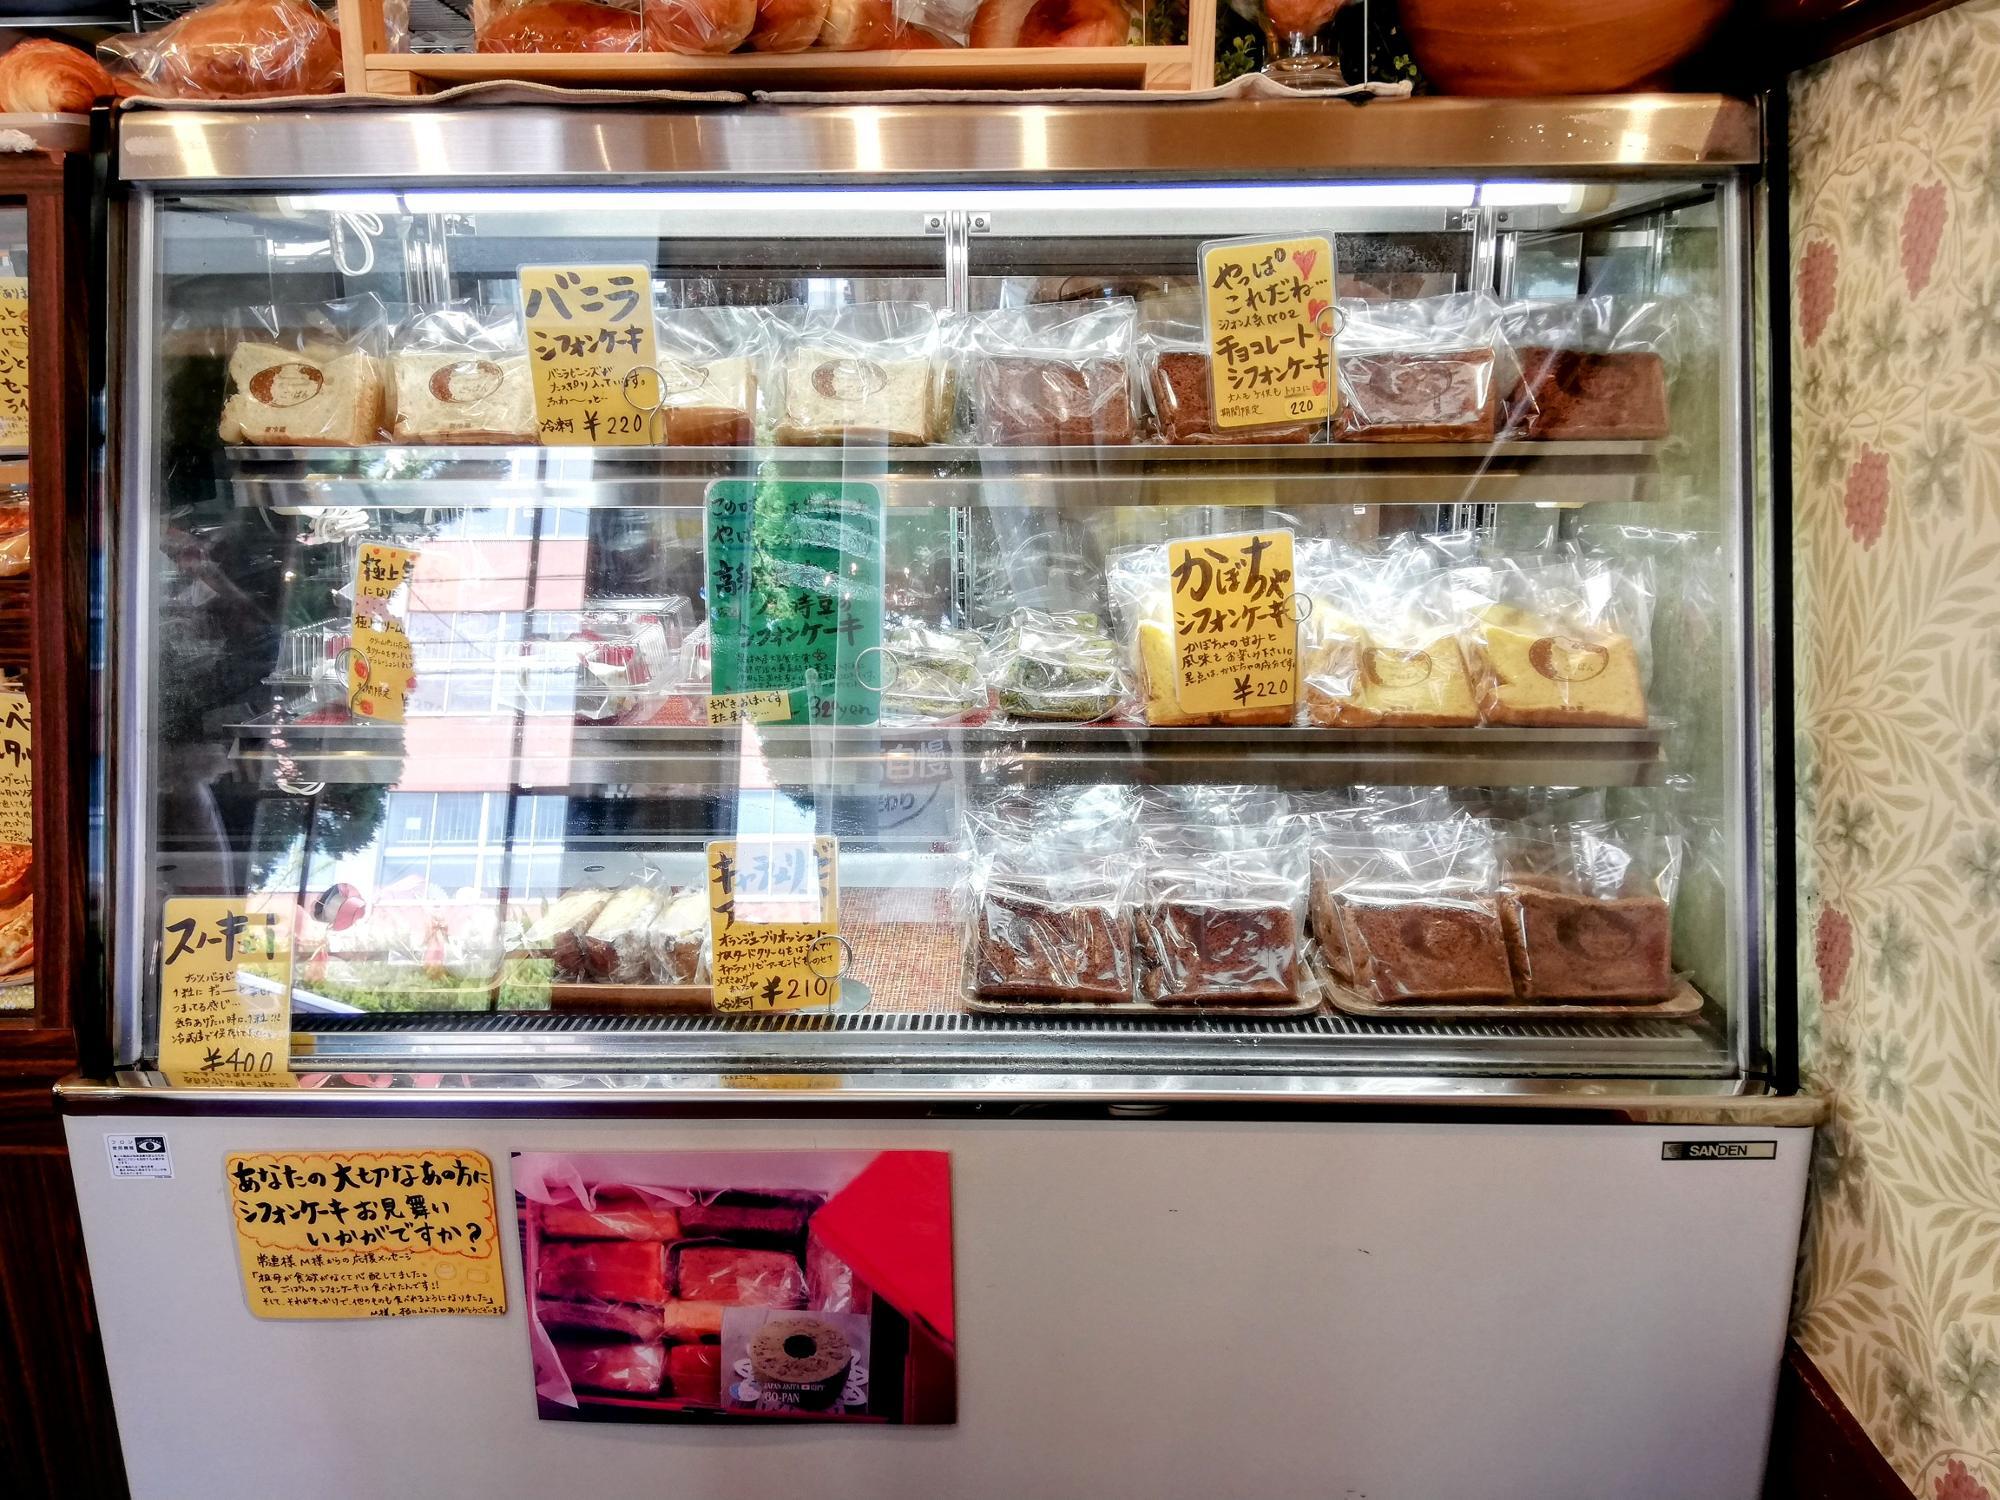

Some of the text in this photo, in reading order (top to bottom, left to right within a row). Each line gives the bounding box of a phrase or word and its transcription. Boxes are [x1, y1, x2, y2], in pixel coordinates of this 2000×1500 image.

[1212, 248, 1286, 290] やっぱ
[526, 272, 640, 321] バニラ
[1215, 323, 1314, 366] チョコレート
[1290, 399, 1314, 415] 220
[1171, 536, 1291, 602] かぼちゃ
[1689, 1145, 1748, 1157] SANDEN
[232, 1159, 490, 1193] あなたの大切なあの方に
[239, 1195, 450, 1226] シフォンケーキお見舞い
